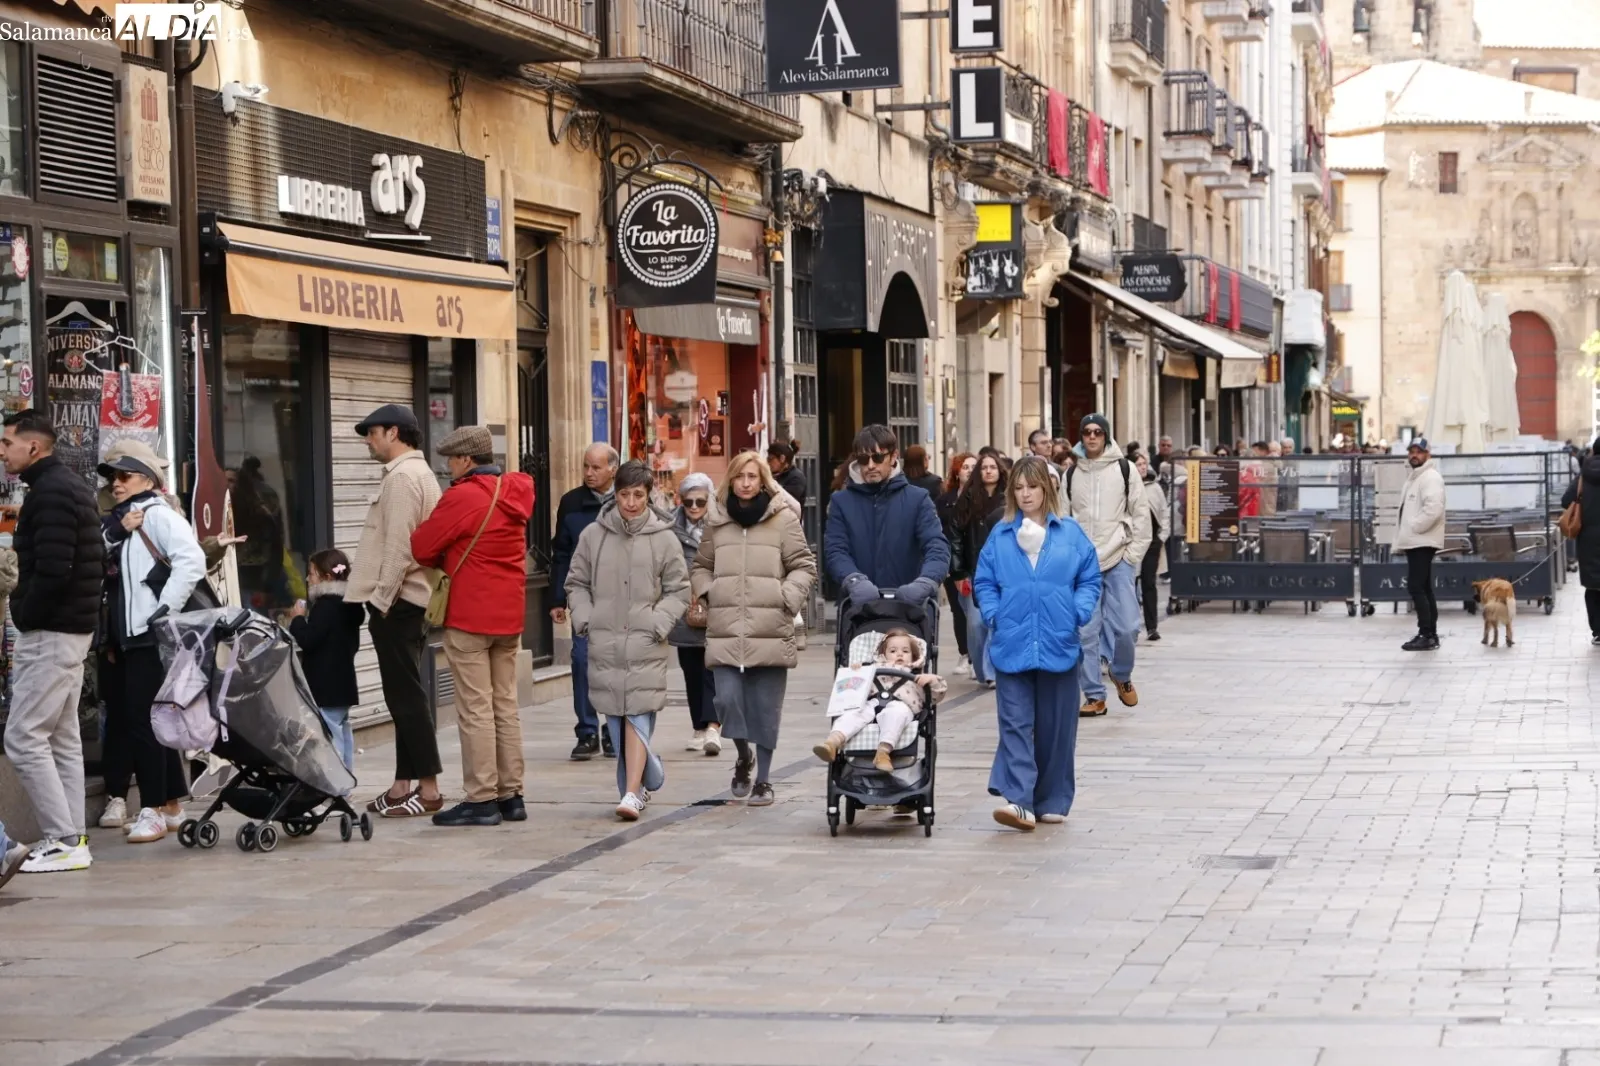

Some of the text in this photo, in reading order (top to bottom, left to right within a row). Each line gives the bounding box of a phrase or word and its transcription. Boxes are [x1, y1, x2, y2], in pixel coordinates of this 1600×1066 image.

[277, 153, 426, 230] LIBRERIA ars
[652, 199, 679, 226] La
[626, 224, 708, 247] Favorita
[648, 254, 687, 264] LO BUENO
[297, 274, 464, 334] LIBRERIA ars
